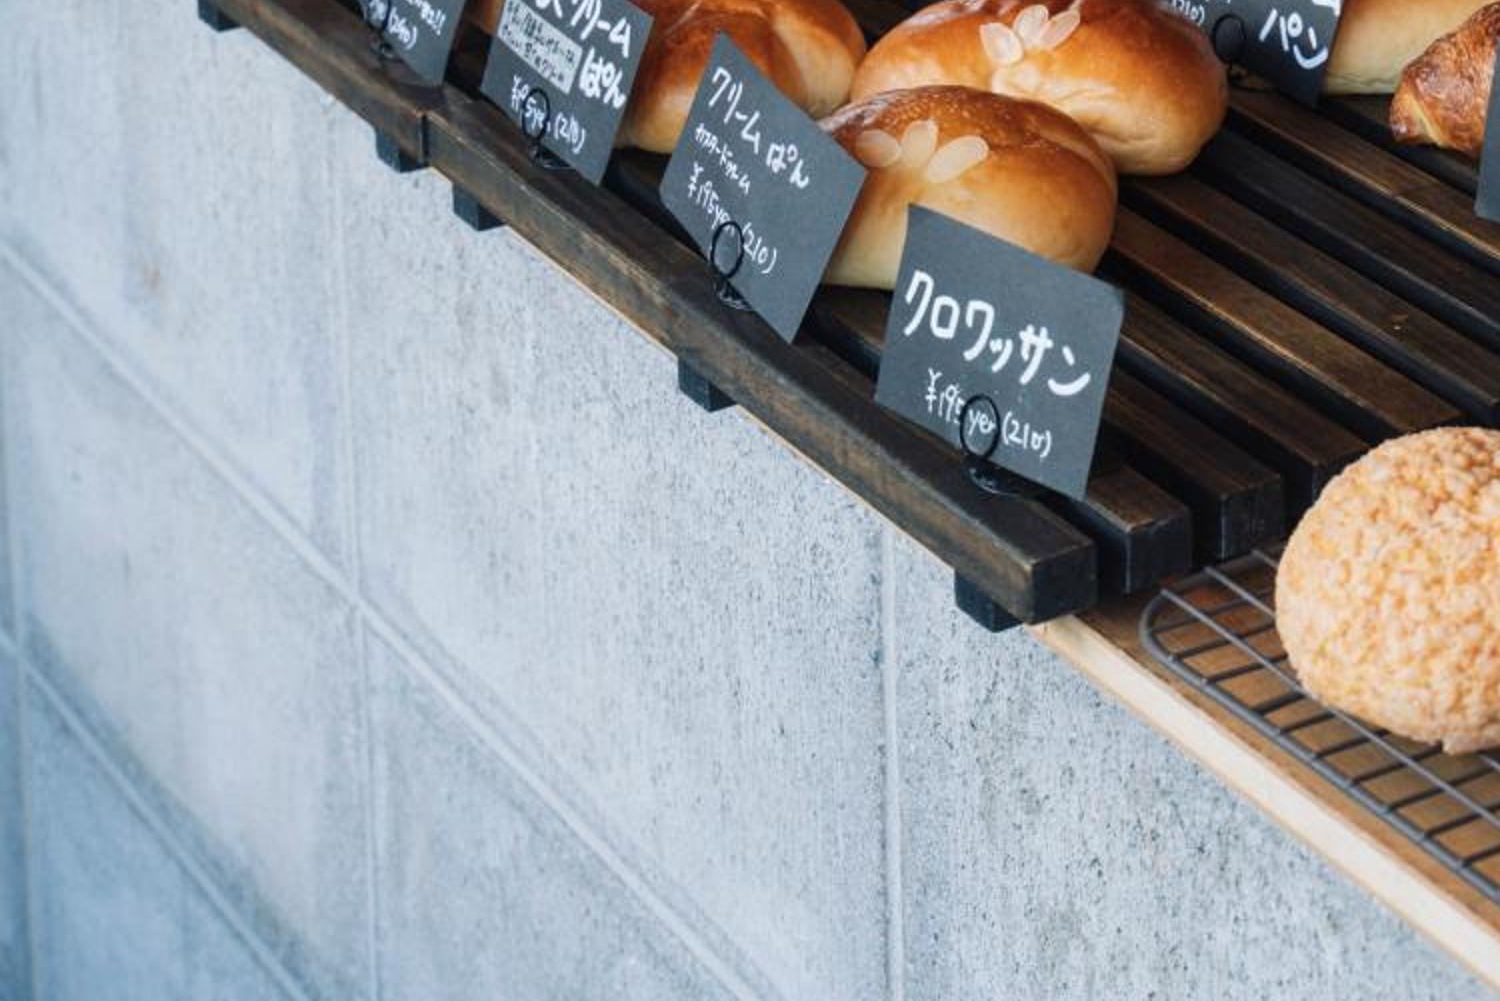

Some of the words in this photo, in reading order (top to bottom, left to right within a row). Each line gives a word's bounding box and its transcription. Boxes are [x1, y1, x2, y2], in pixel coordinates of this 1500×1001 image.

[1259, 8, 1329, 70] パン
[904, 269, 1092, 397] クロワッサン
